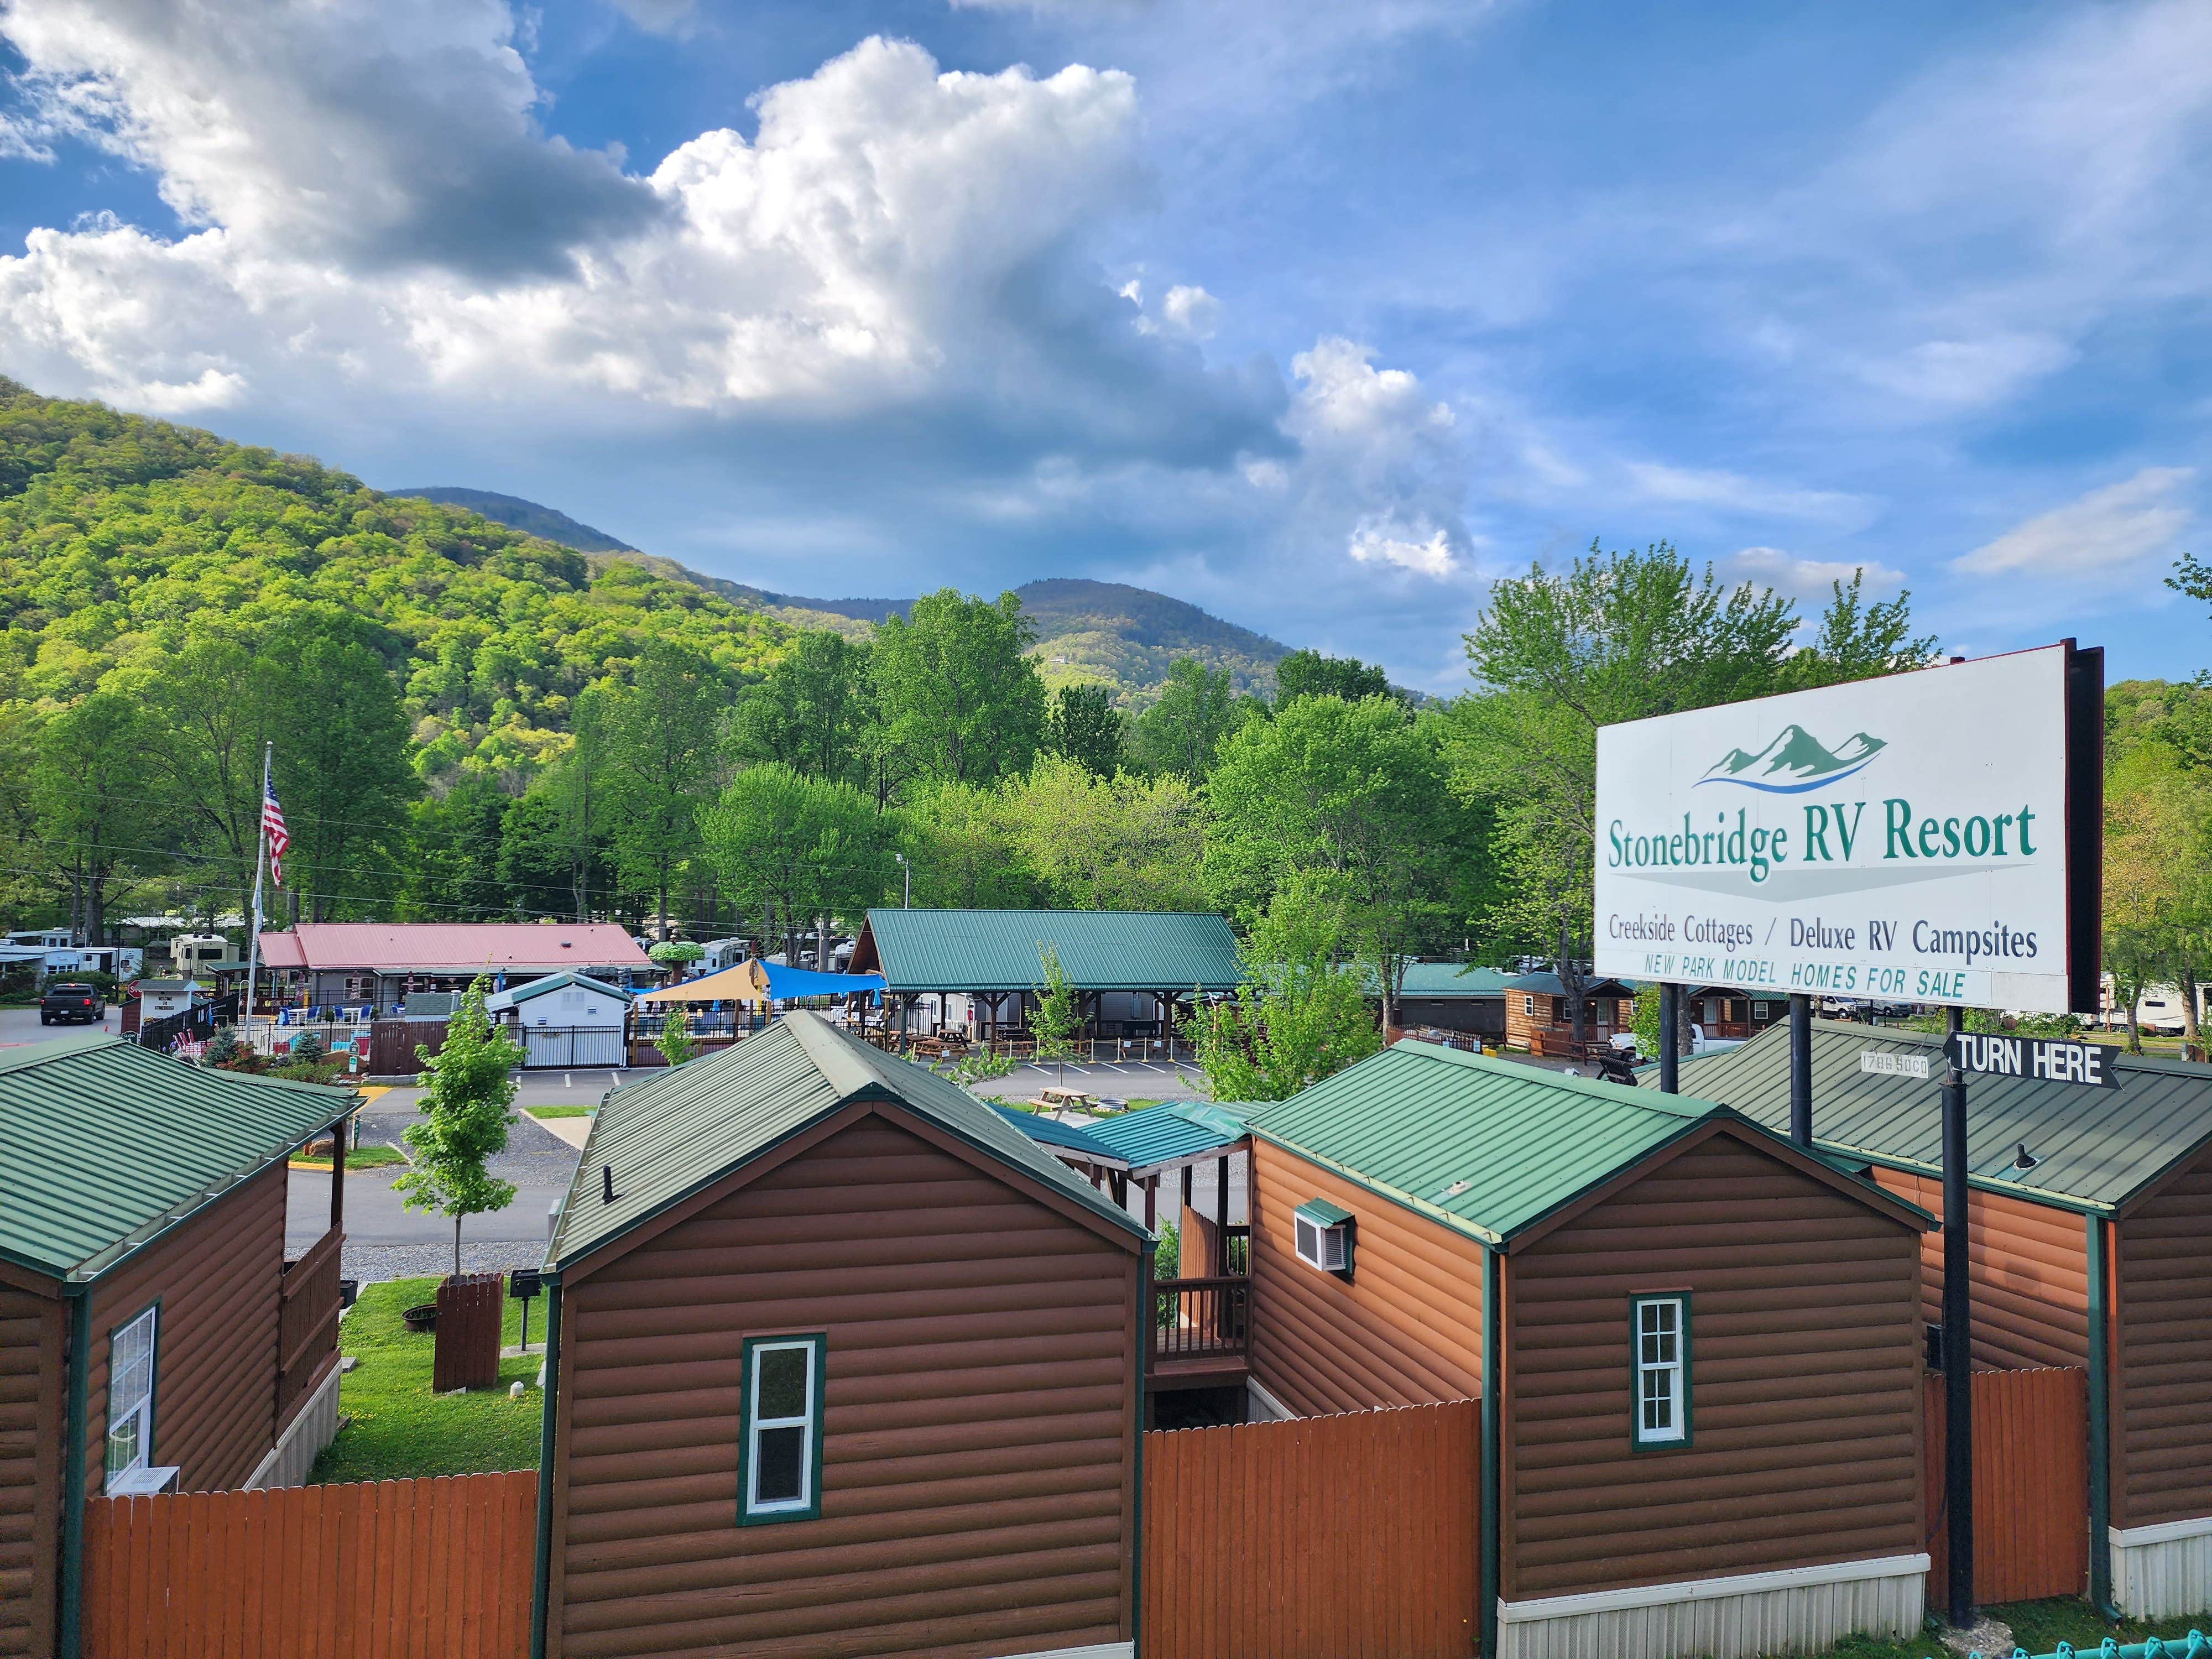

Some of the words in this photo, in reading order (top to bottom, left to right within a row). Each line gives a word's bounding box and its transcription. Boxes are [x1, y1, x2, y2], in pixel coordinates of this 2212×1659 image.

[1609, 807, 1788, 883] Stonebridge
[1803, 802, 1866, 862] RV
[1882, 799, 2037, 859] Resort
[1609, 913, 1675, 941] Creekside
[1684, 915, 1753, 953] Cottages
[1790, 916, 1855, 951] Deluxe
[1869, 920, 1898, 951] RV
[1912, 919, 2037, 966] Campsites
[1645, 953, 1676, 975] NEW
[1682, 956, 1715, 979] PARK
[1723, 959, 1776, 984] MODEL
[1791, 963, 1857, 990] HOMES
[1866, 967, 1906, 994] FOR
[1916, 970, 1966, 999] SALE
[1956, 1034, 2022, 1076] TURN
[2032, 1041, 2103, 1084] HERE
